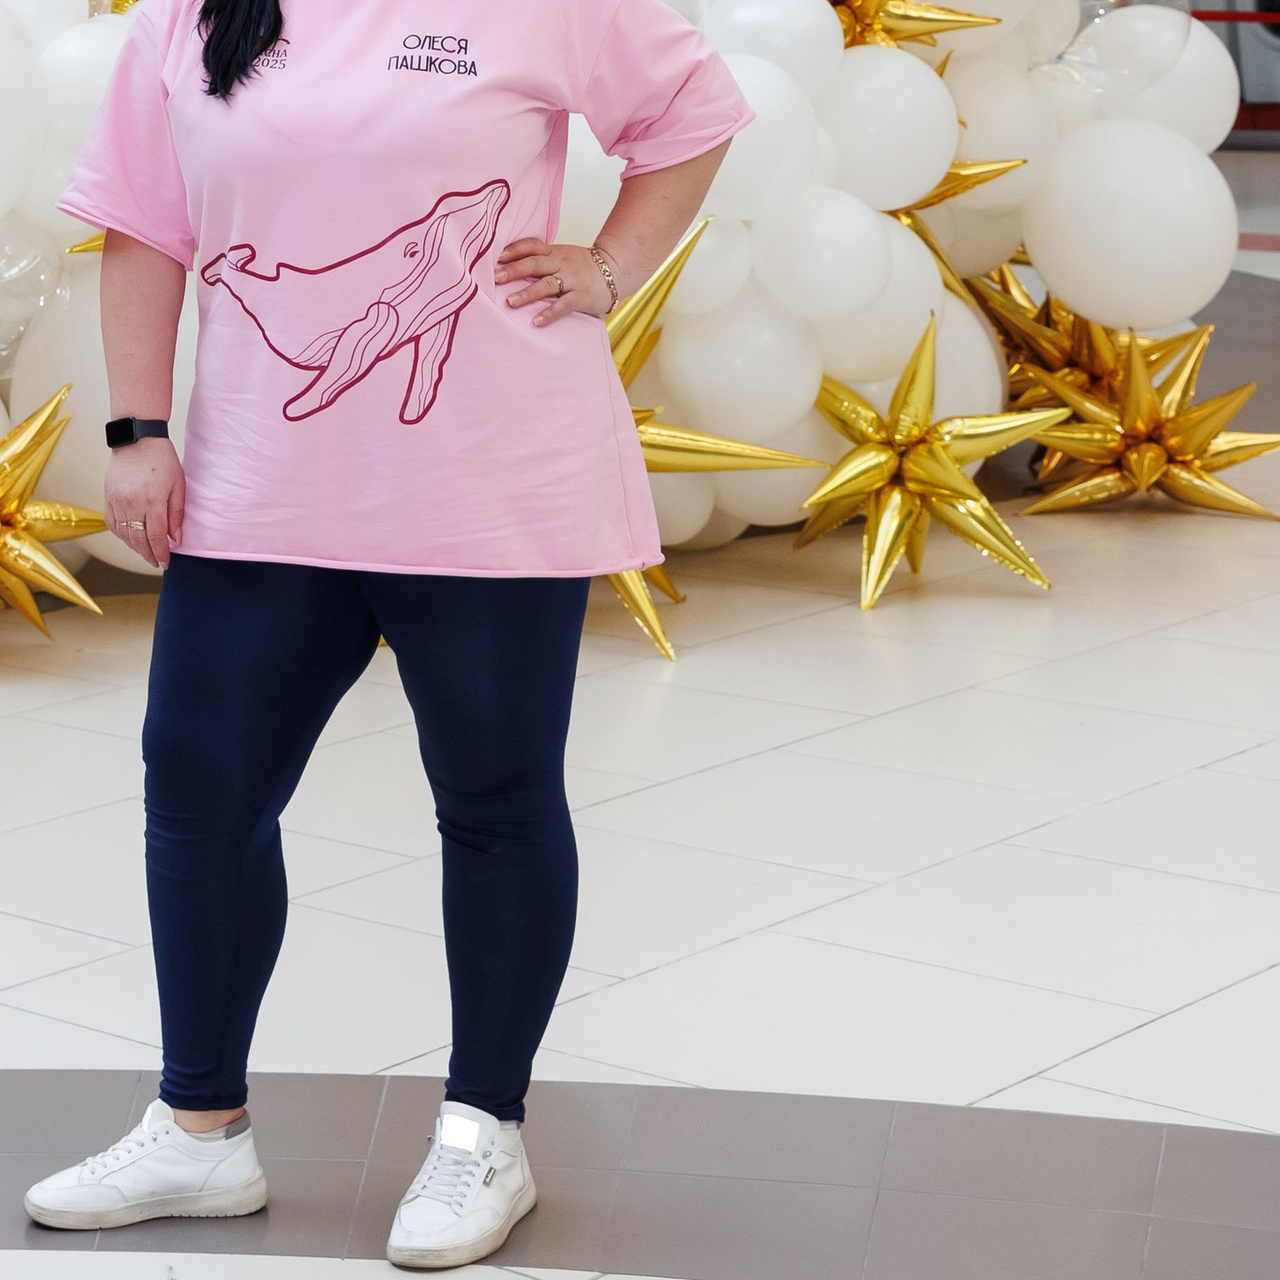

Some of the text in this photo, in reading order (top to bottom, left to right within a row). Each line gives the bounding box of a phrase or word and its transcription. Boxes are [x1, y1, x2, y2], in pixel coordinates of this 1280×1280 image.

[403, 34, 468, 55] ОЛЕСЯ
[253, 56, 288, 70] 2025
[387, 55, 478, 77] ПАШКОВА
